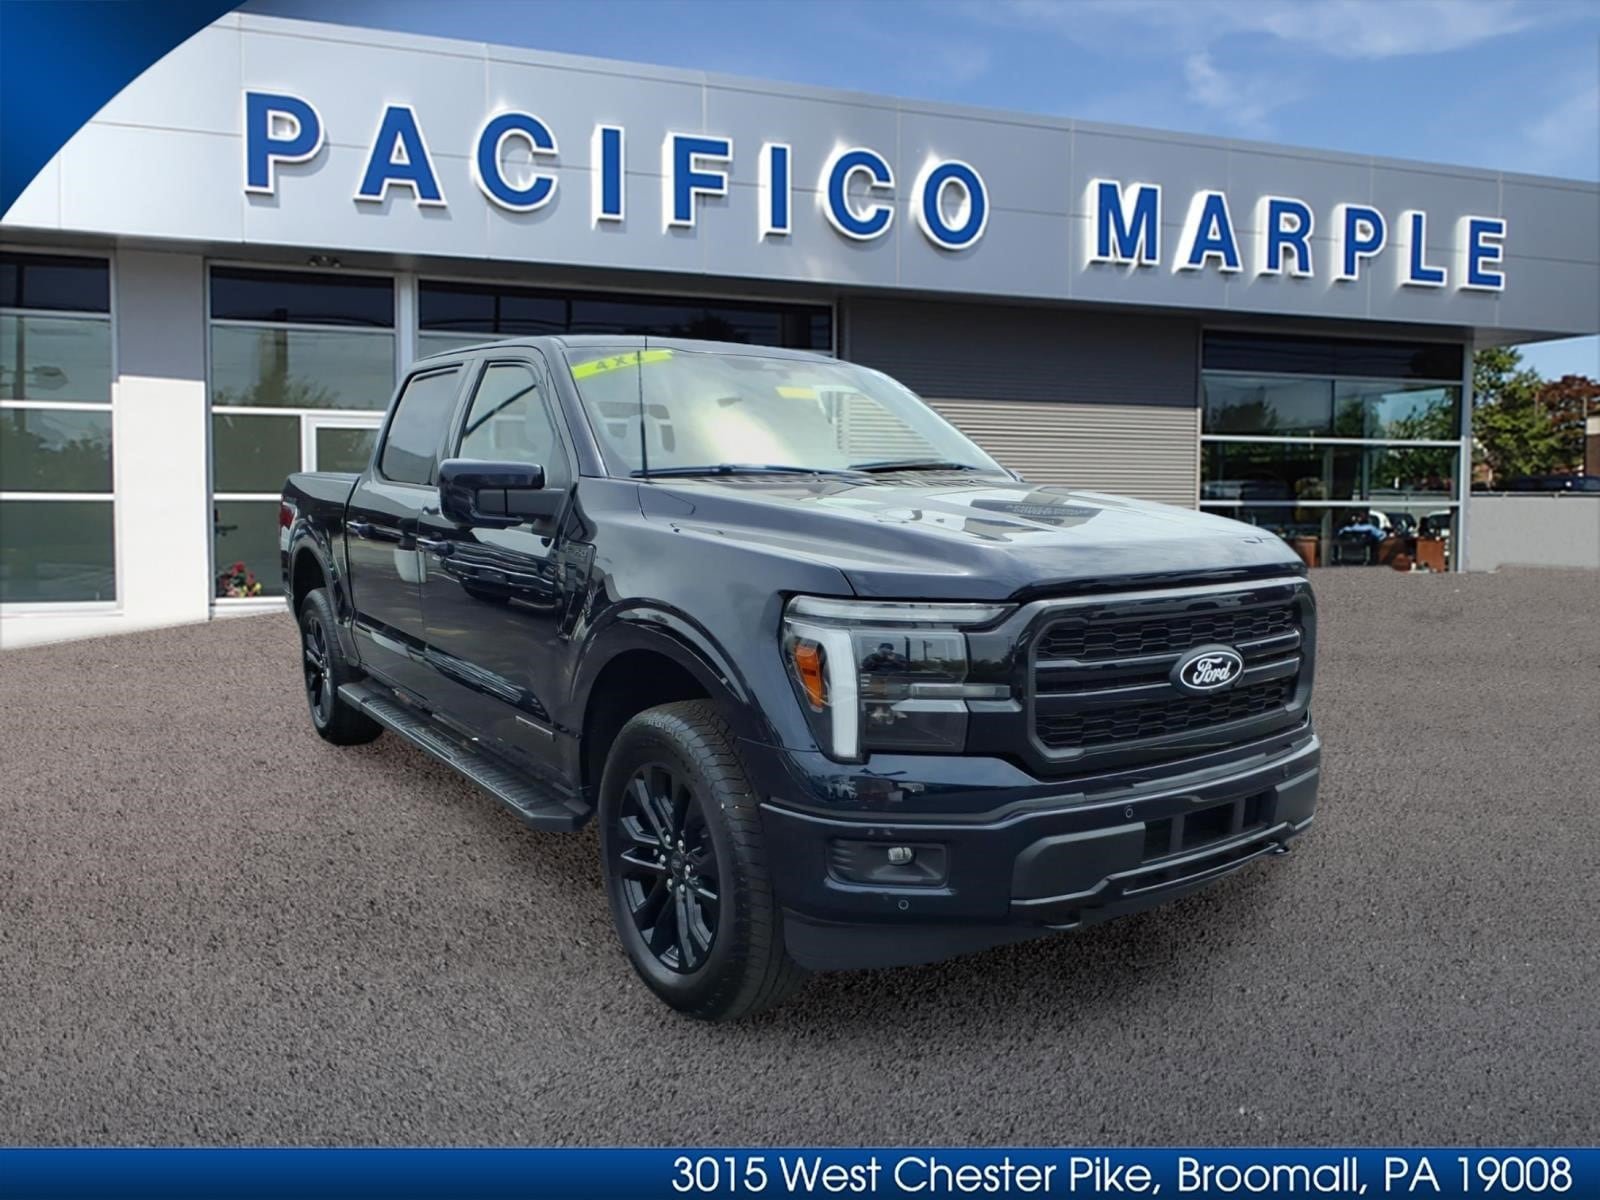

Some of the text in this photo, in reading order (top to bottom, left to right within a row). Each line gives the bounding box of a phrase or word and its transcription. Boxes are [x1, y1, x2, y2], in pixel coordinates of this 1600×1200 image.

[243, 88, 1507, 292] PACIFICO MARPLE
[1192, 656, 1233, 685] Ford
